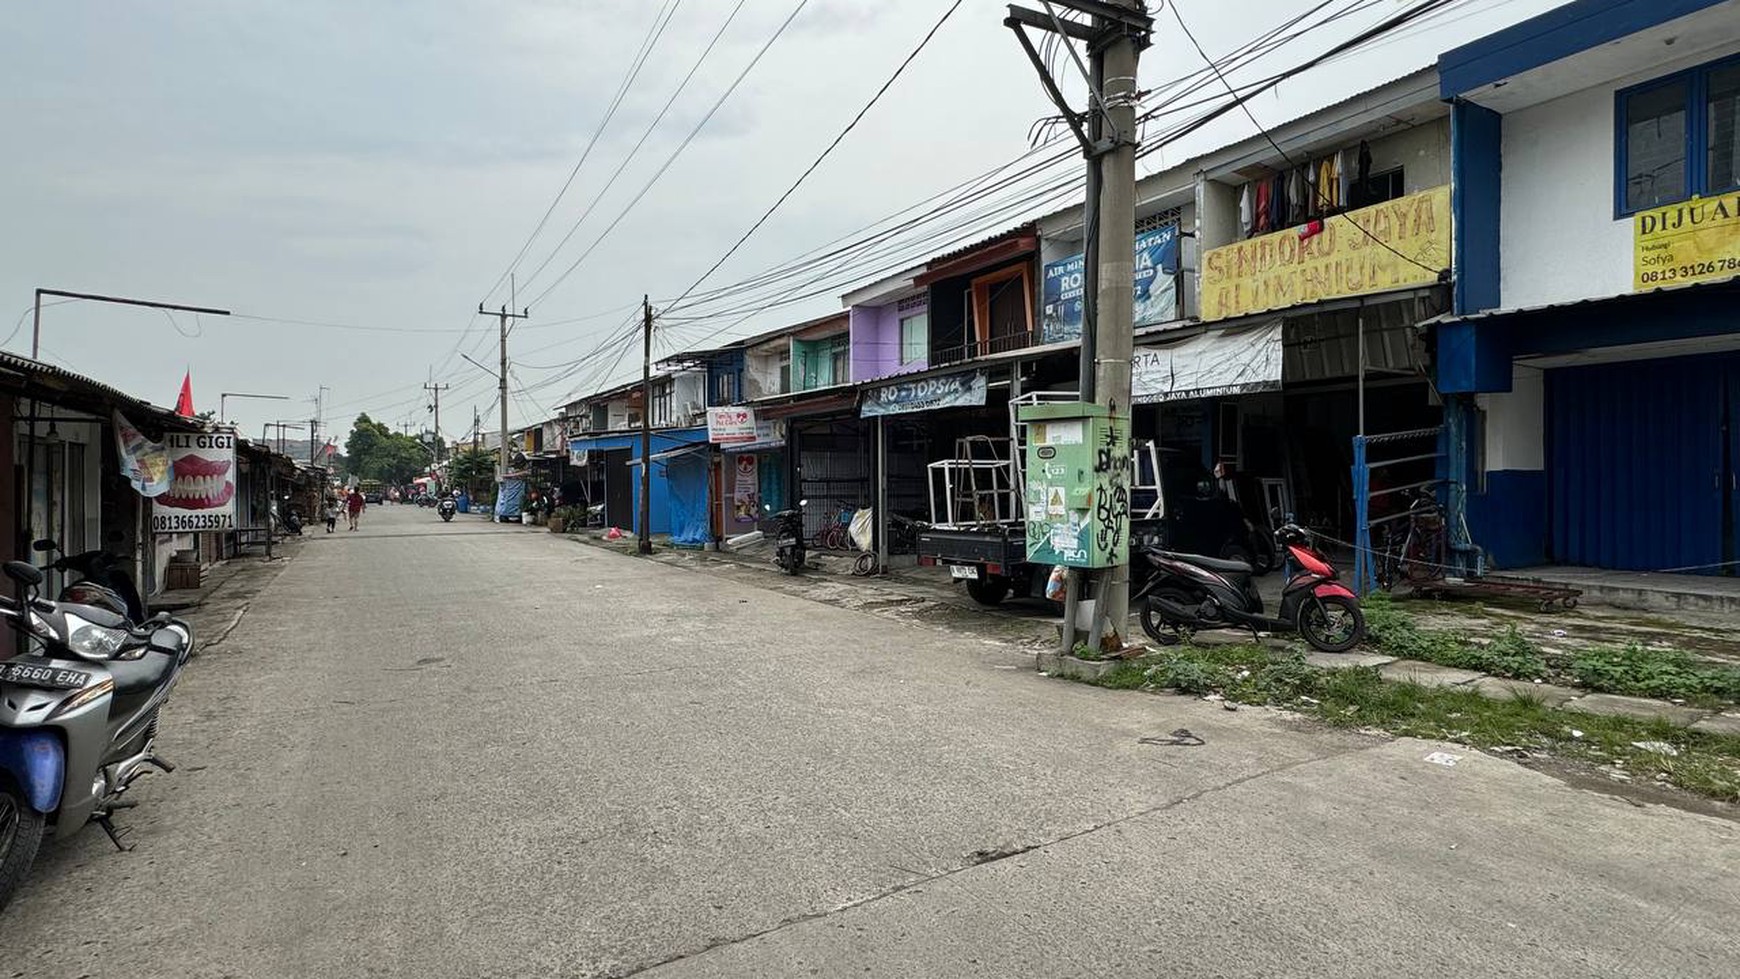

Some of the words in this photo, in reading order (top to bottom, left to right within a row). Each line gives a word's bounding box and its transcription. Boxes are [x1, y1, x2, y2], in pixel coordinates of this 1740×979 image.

[1347, 194, 1437, 251] JAYA
[1641, 253, 1674, 267] Sofya
[1046, 264, 1065, 279] AIR
[1641, 268, 1677, 283] 0813
[1679, 261, 1715, 277] 3126
[1166, 390, 1187, 401] JAYA
[1188, 386, 1240, 398] ALUMINIUM
[196, 435, 232, 450] GIGI
[153, 513, 233, 531] 081366235971
[56, 671, 87, 687] EHA
